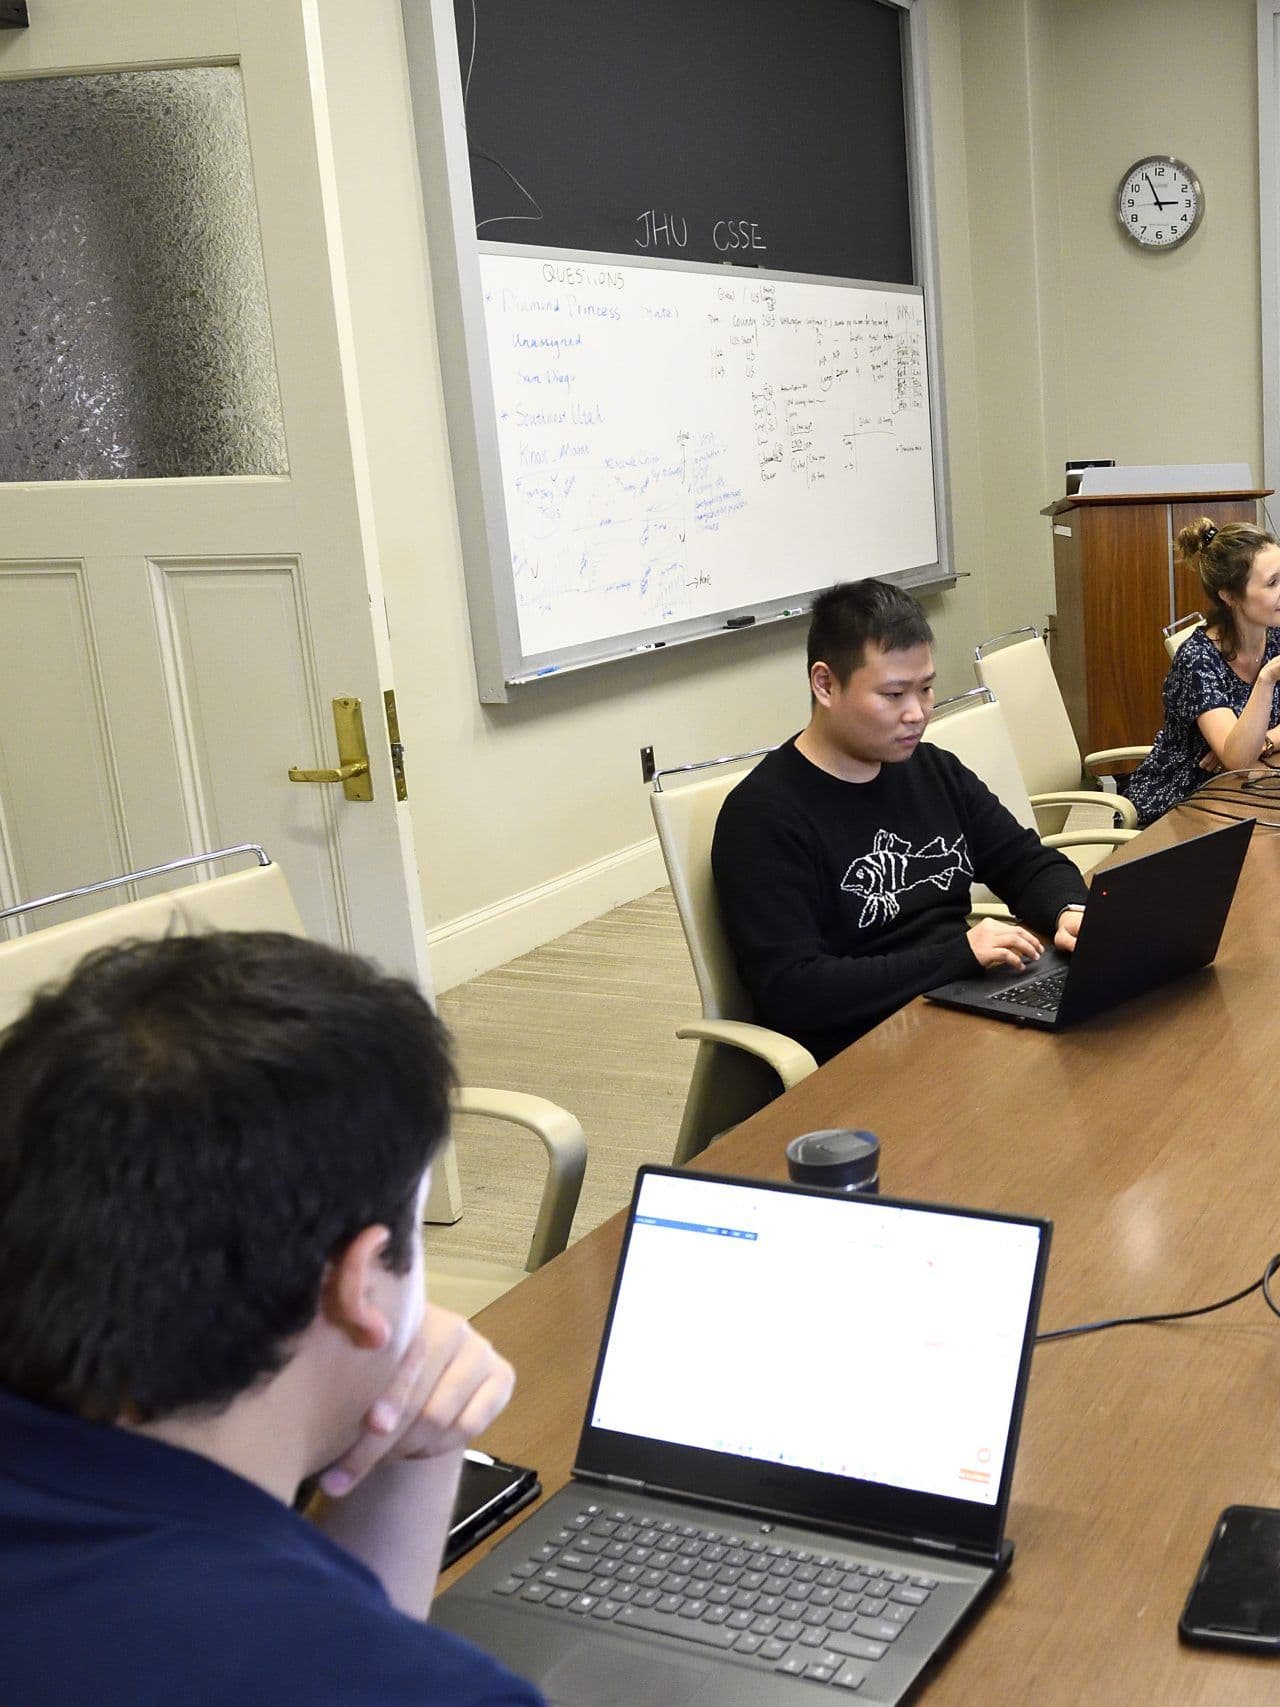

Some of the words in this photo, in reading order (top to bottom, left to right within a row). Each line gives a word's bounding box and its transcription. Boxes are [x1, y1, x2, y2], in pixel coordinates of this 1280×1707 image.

[1155, 168, 1164, 176] 12
[1132, 184, 1140, 192] 10
[1181, 184, 1188, 192] 2
[1128, 199, 1134, 207] 9
[1185, 200, 1191, 208] 3
[1131, 214, 1138, 222] 8
[634, 210, 688, 248] JHU
[712, 220, 767, 251] CSSE
[1141, 226, 1147, 234] 7
[1171, 226, 1177, 234] 5
[1156, 231, 1162, 239] 6
[512, 334, 584, 359] Unassigned
